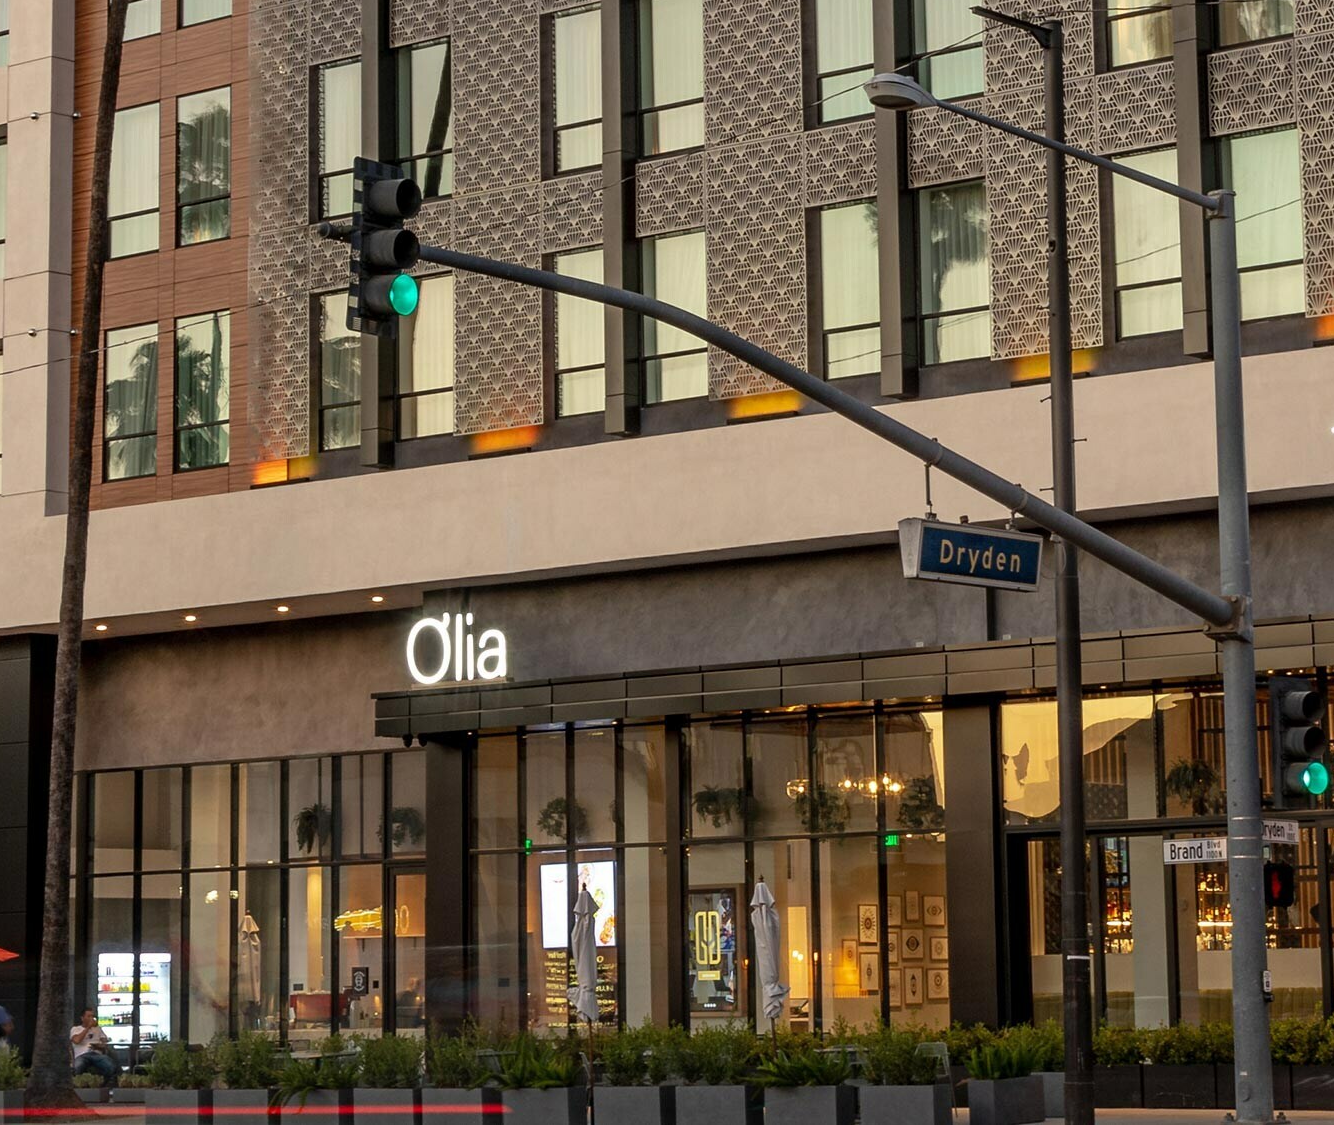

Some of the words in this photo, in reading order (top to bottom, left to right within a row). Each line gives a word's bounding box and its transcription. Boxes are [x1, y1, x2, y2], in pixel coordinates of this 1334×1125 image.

[939, 539, 1021, 574] Dryden
[1169, 843, 1203, 860] Brand
[1207, 840, 1221, 849] Blvd
